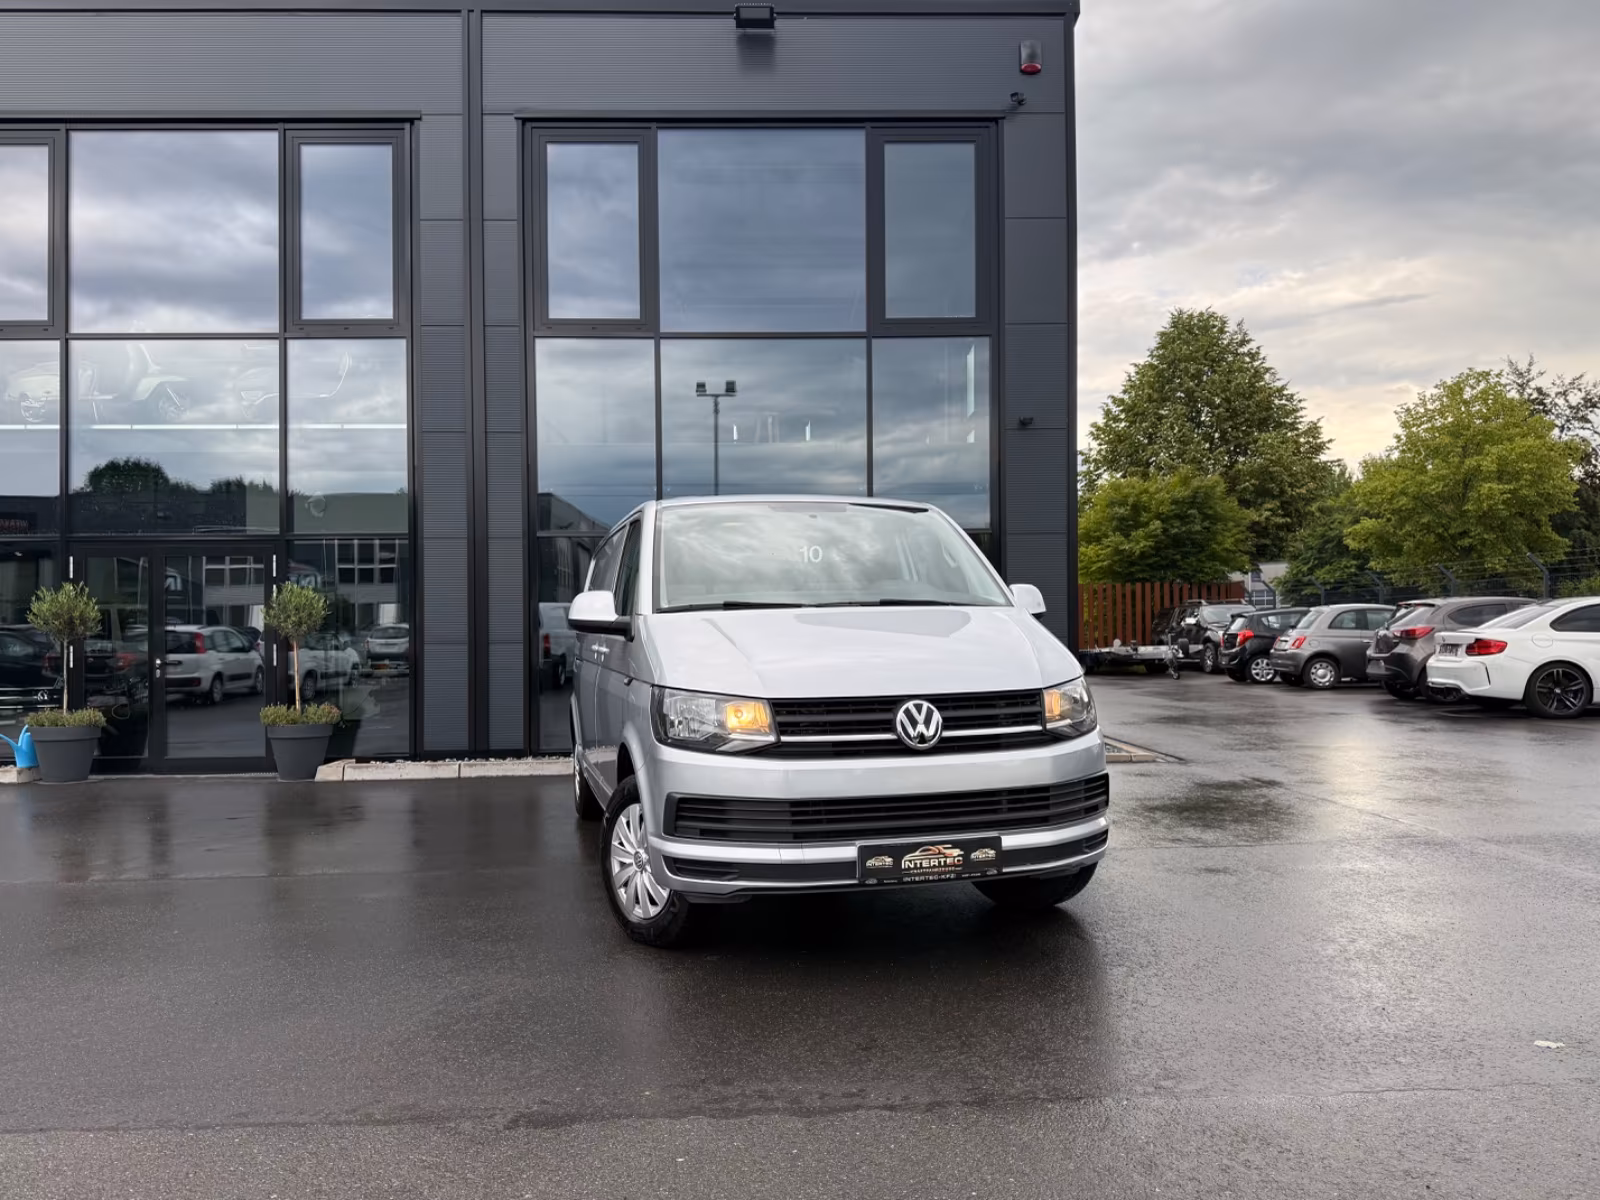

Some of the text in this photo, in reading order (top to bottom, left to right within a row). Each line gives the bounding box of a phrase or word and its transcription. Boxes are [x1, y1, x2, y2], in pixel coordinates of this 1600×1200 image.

[799, 545, 823, 563] 10
[898, 701, 941, 748] VW
[902, 856, 963, 869] INTERTEC
